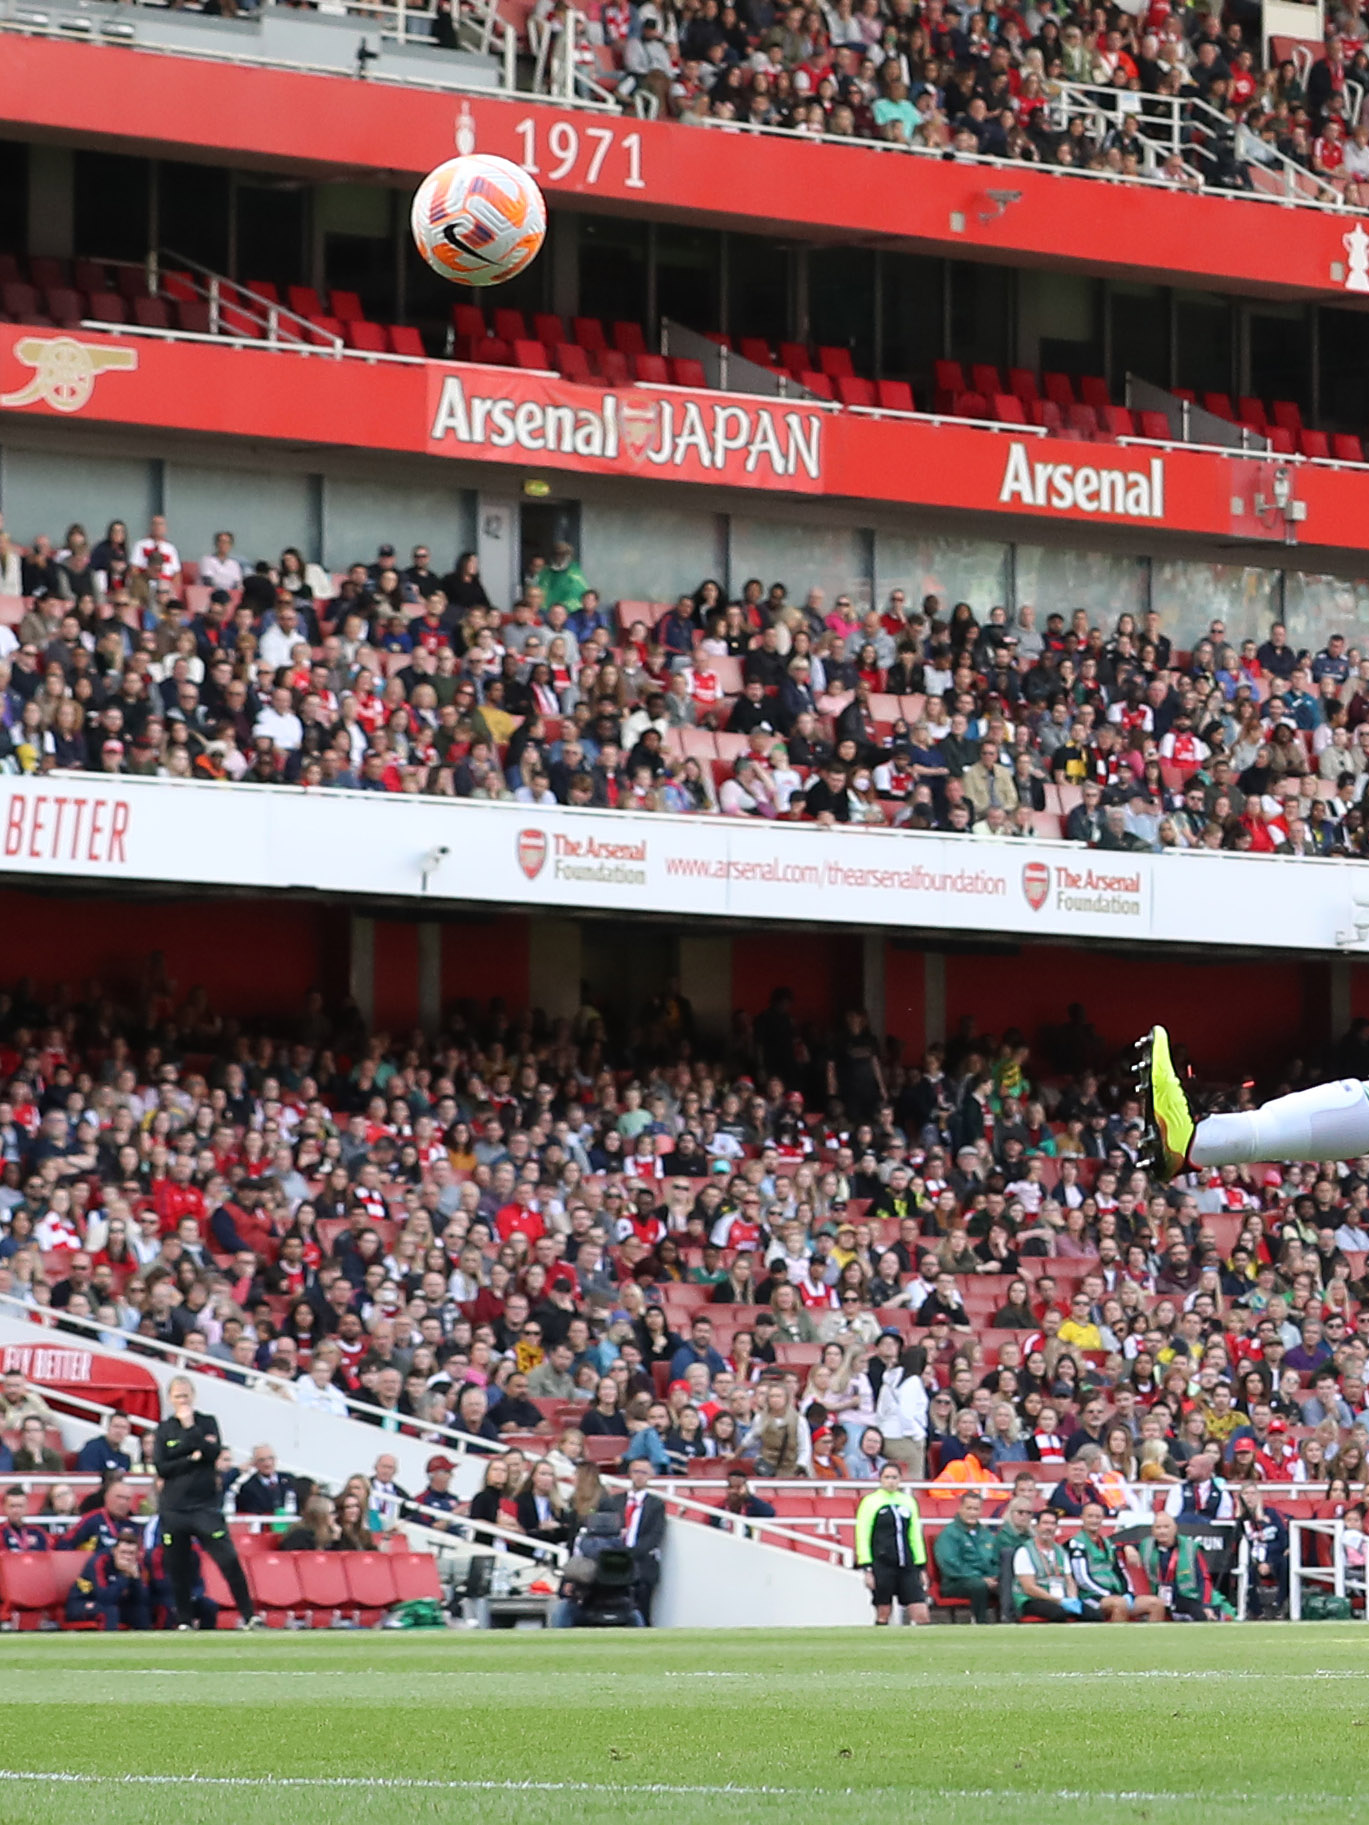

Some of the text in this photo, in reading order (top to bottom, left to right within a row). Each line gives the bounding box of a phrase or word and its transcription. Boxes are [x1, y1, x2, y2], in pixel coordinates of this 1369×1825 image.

[515, 117, 646, 188] 1971
[431, 375, 821, 480] Arsenal JAPAN
[999, 442, 1164, 518] Arsenal
[4, 793, 131, 863] BETTER
[553, 834, 647, 861] The Arsenal
[554, 859, 646, 884] Foundation
[666, 856, 1006, 896] www.arsenal.com/thearsenalfoundation
[1055, 866, 1140, 893] The Arsenal
[1057, 891, 1140, 915] Foundation
